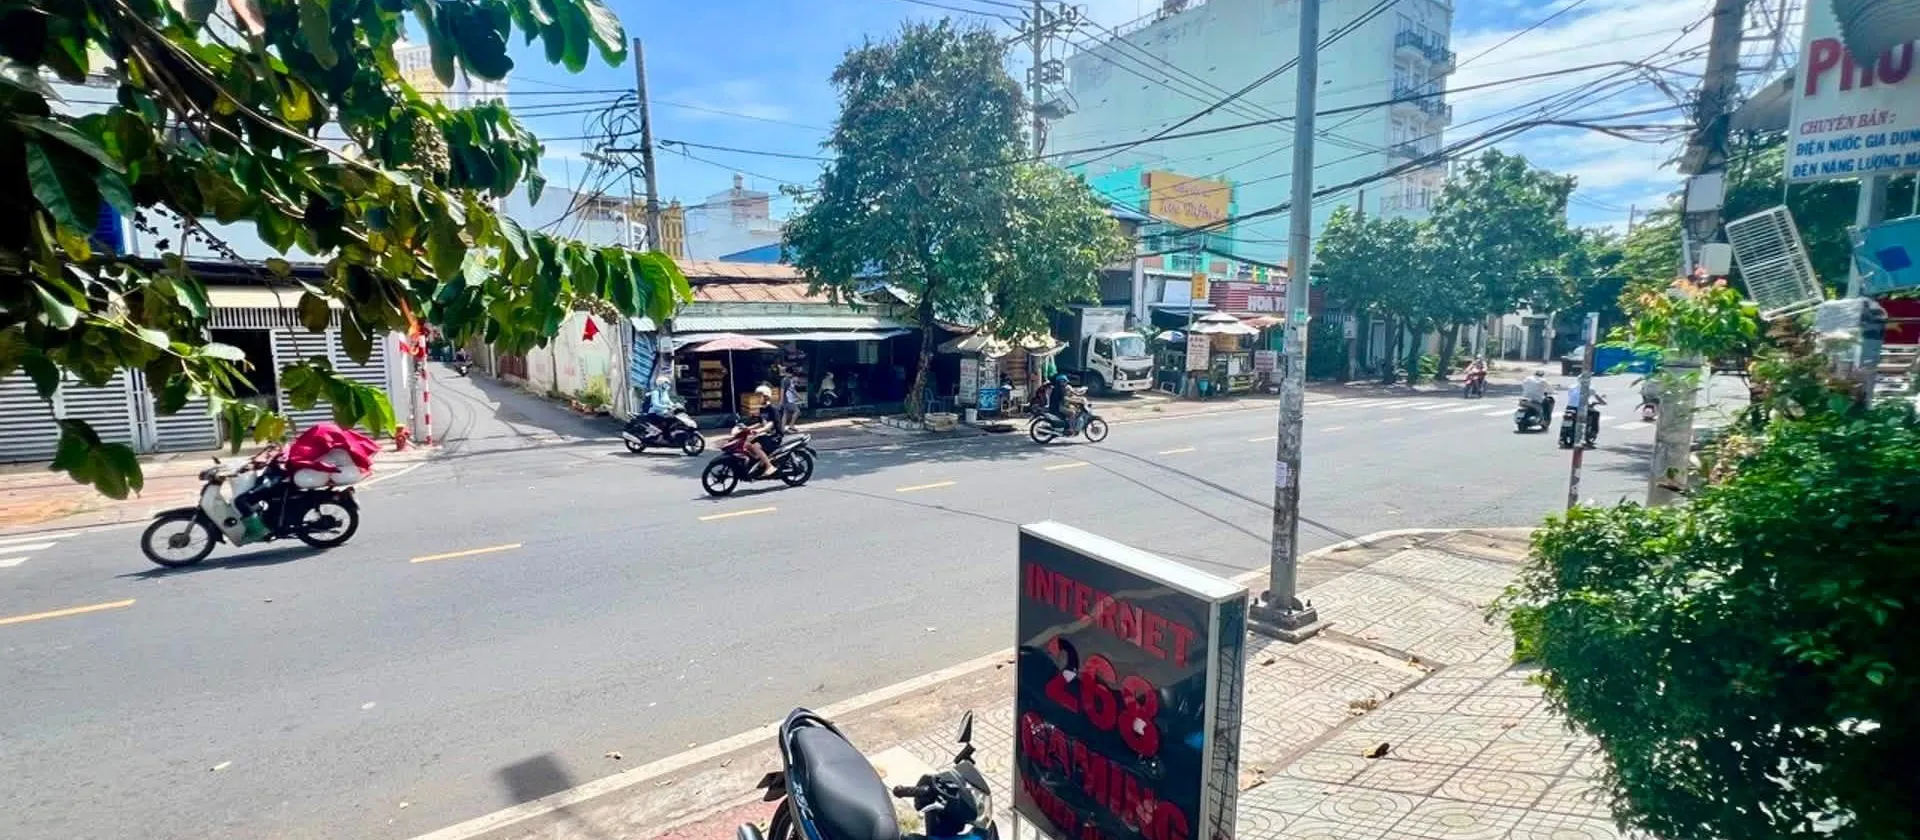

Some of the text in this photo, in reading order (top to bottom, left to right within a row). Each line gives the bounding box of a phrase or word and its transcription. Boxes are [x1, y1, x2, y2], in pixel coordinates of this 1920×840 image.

[1796, 139, 1825, 157] ĐIỆN
[1828, 134, 1862, 152] NƯỚC
[1865, 132, 1887, 148] GIA
[1800, 113, 1857, 136] CHUYÊN
[1792, 159, 1819, 178] ĐÈN
[1857, 153, 1901, 172] LƯỢNG
[1025, 562, 1196, 669] INTERNET
[1045, 635, 1161, 758] 268
[1021, 711, 1190, 840] GAMING
